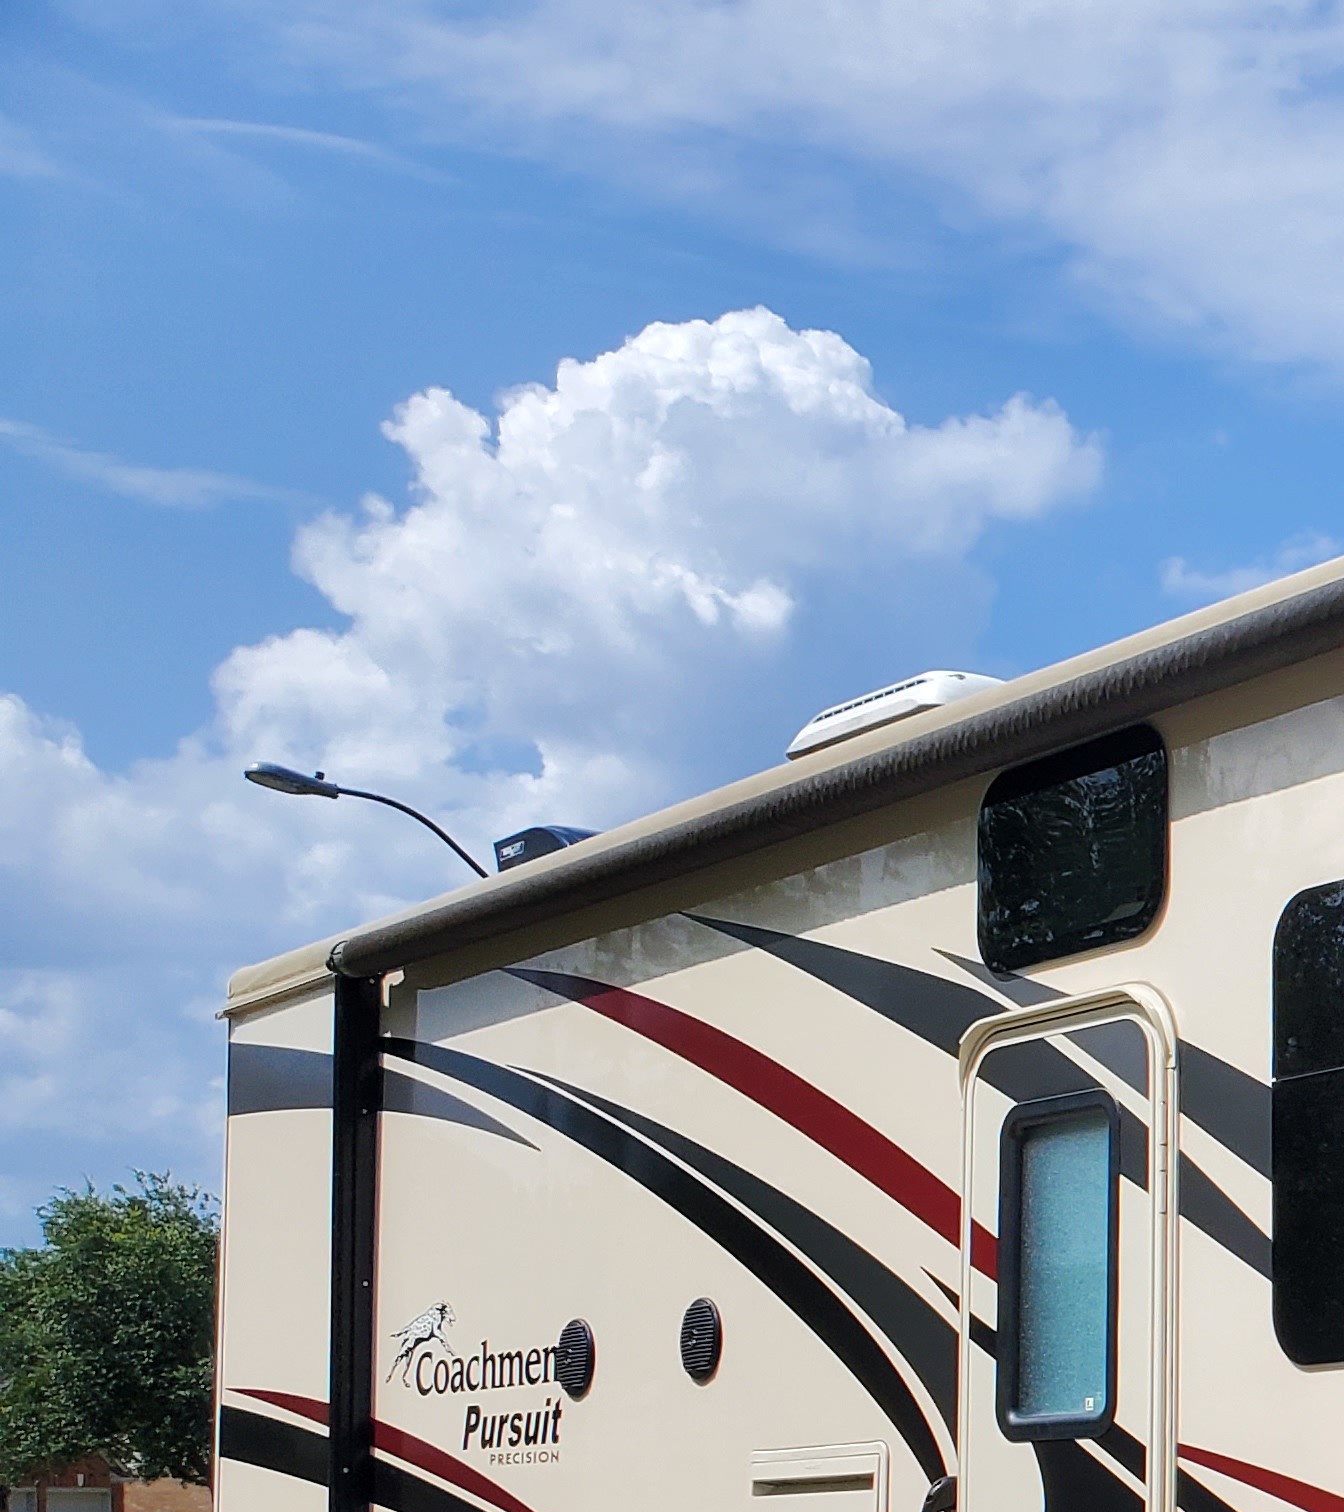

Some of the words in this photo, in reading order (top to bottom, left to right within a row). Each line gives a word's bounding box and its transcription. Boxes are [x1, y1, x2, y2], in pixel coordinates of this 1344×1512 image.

[416, 1340, 559, 1396] Coachmen
[463, 1397, 563, 1450] Pursuit
[490, 1451, 560, 1466] PRECISION
